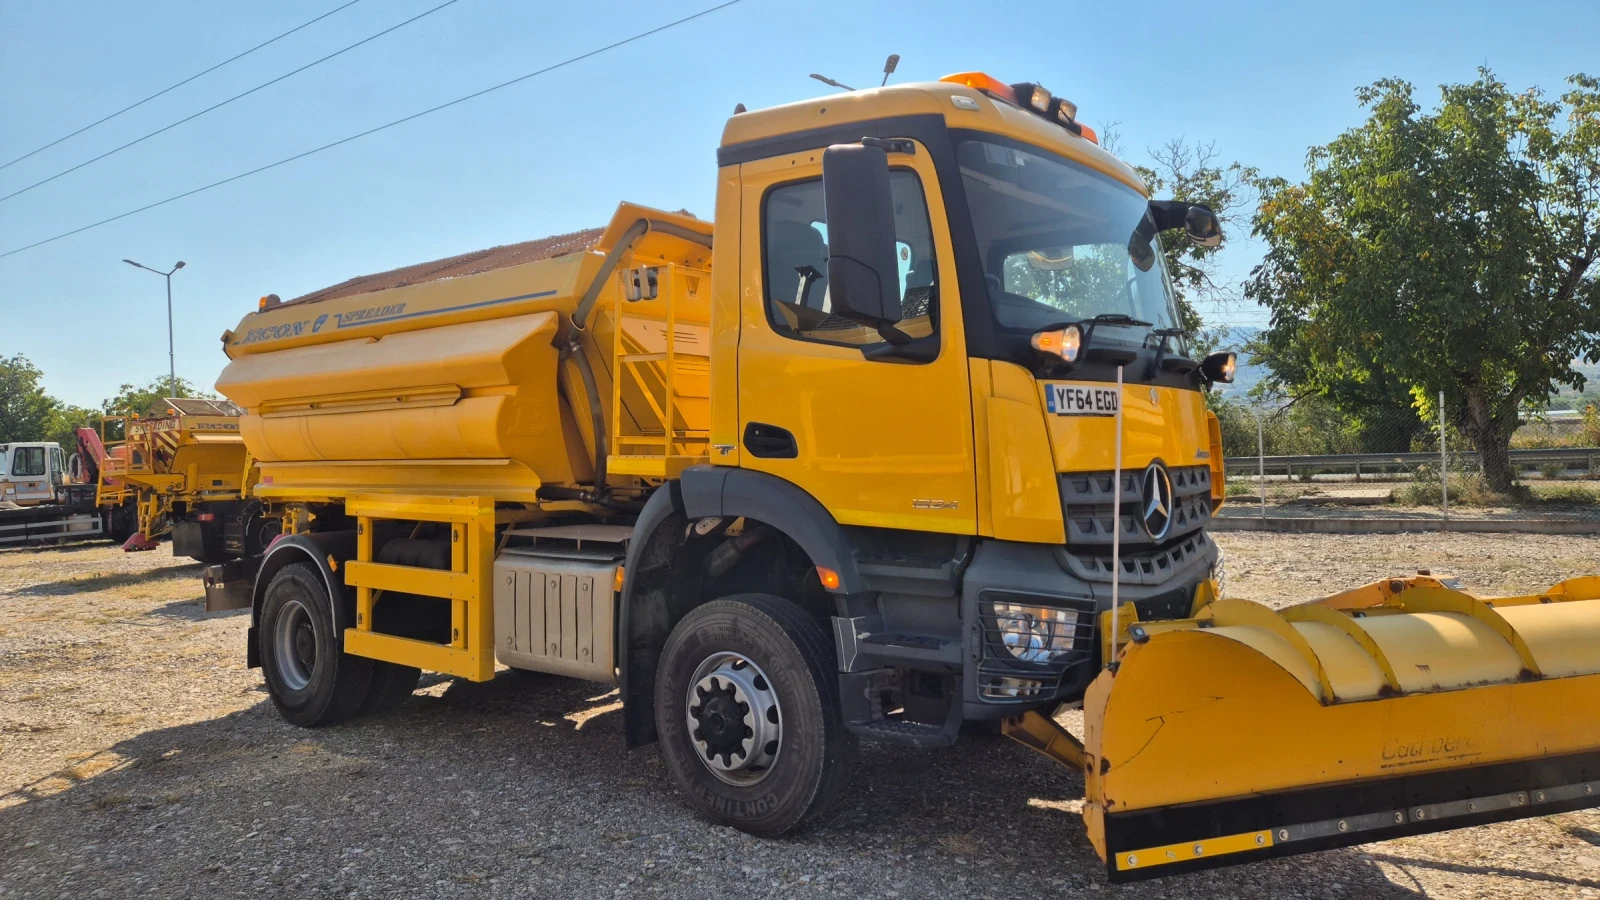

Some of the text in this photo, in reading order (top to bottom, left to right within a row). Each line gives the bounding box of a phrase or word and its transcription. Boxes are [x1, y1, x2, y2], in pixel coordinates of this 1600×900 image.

[342, 303, 407, 323] SPREADER
[242, 320, 310, 344] ECON
[1056, 388, 1118, 411] YF64 EGD
[197, 422, 240, 430] ECO
